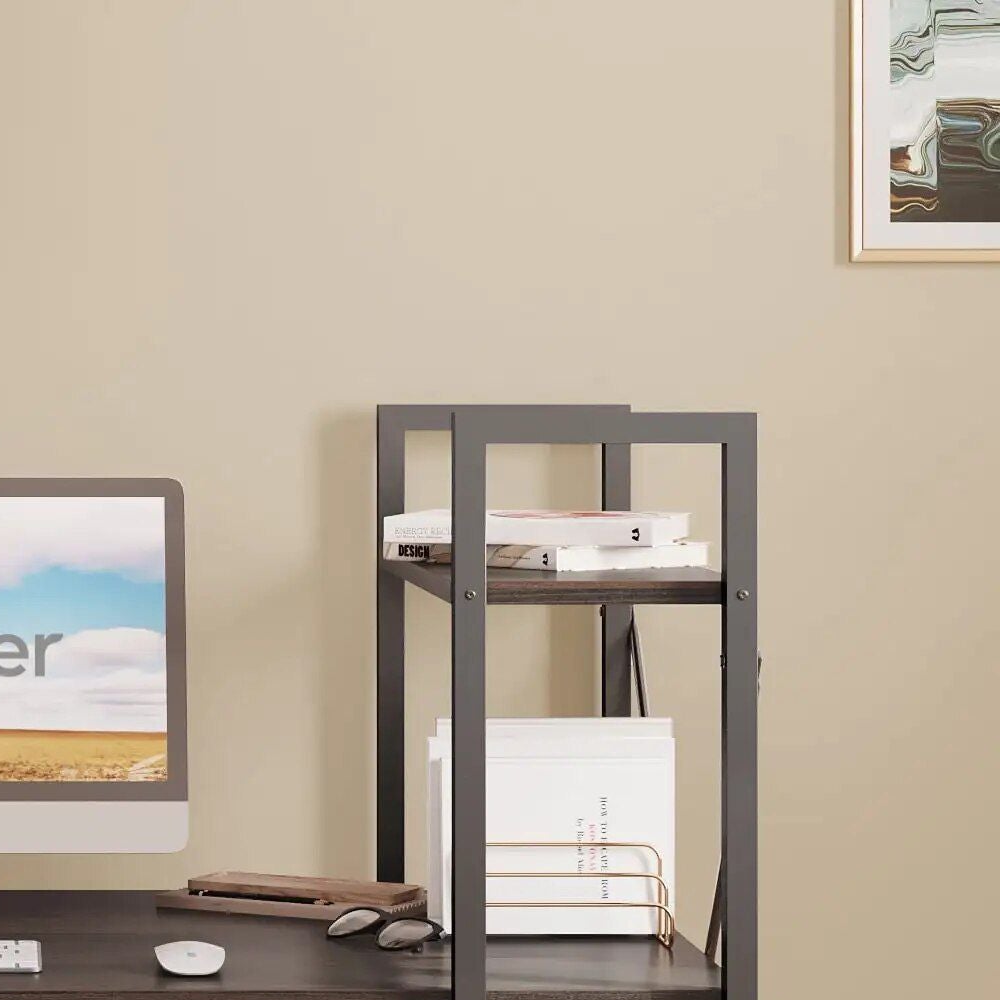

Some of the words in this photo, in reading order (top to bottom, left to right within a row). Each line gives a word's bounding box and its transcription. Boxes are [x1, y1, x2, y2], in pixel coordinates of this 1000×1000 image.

[398, 543, 430, 559] DESIGN
[600, 796, 608, 817] HOW
[600, 822, 608, 834] TO
